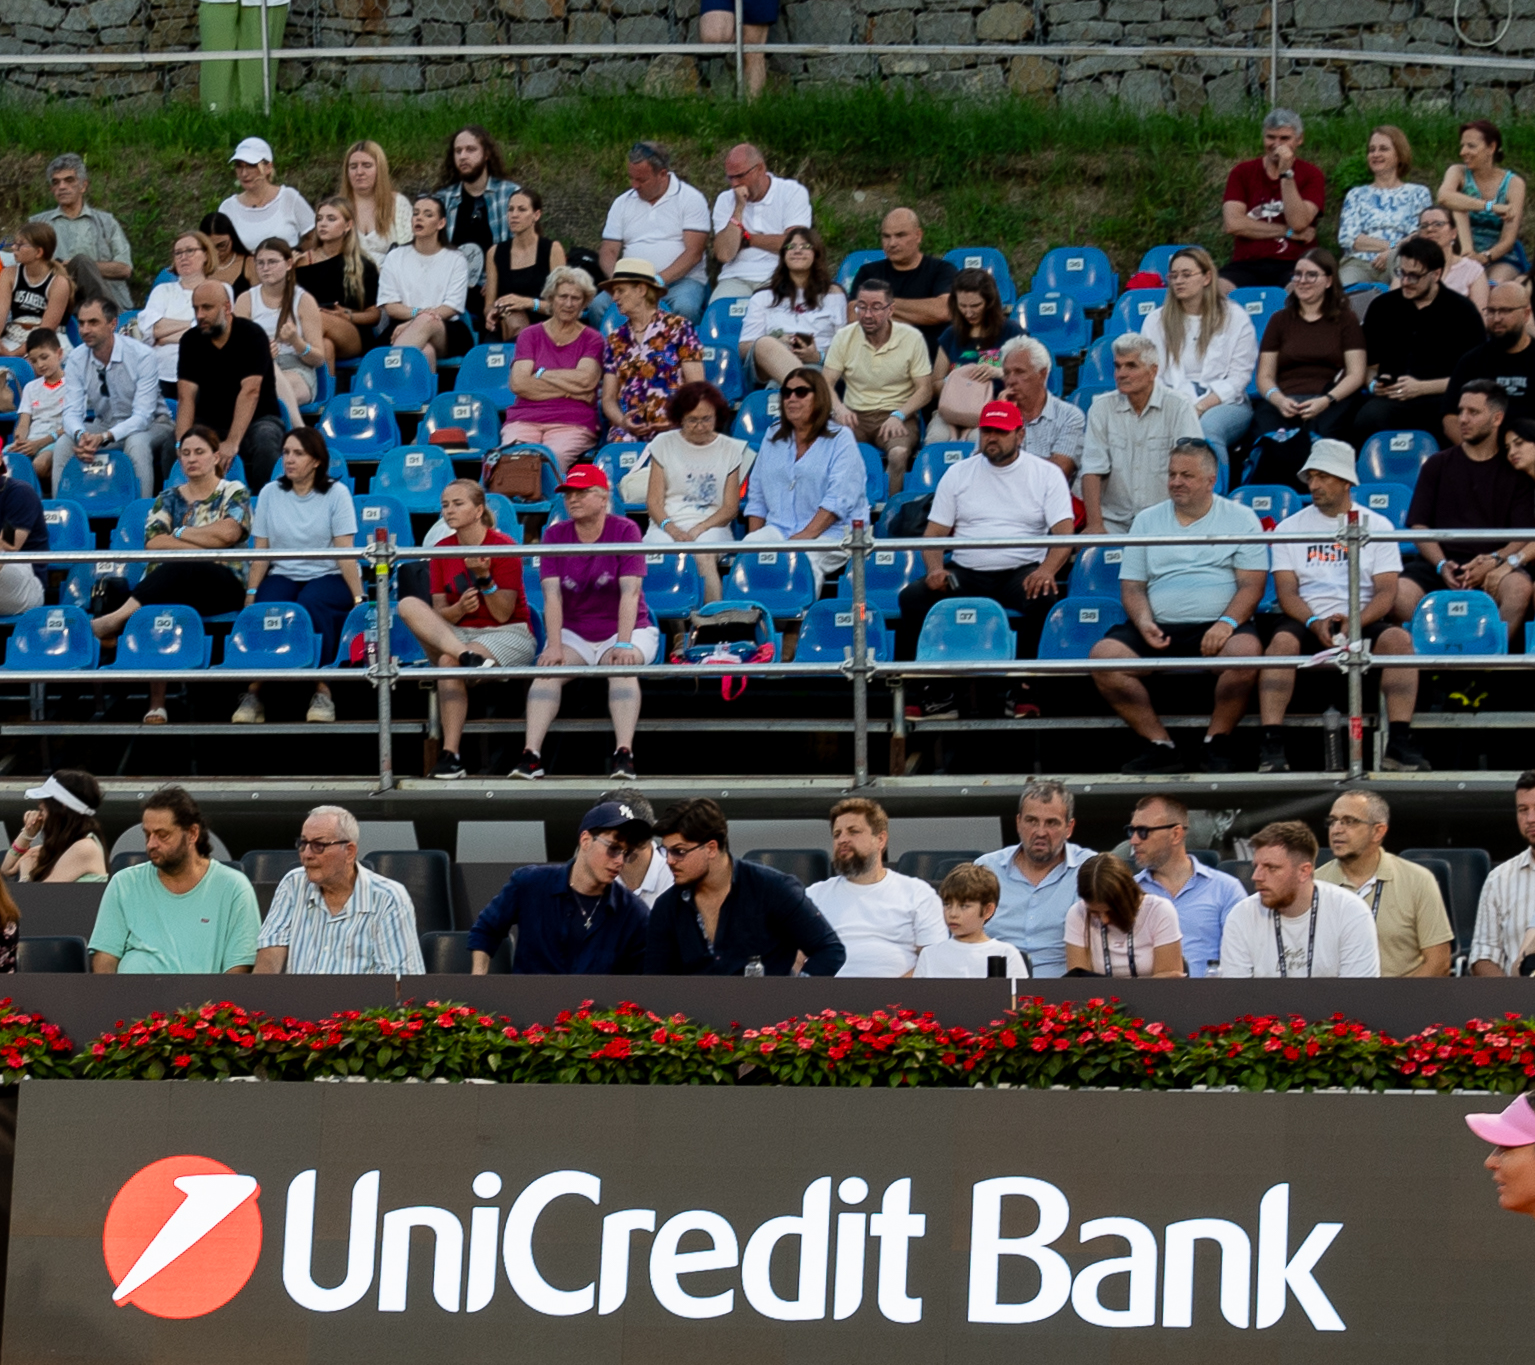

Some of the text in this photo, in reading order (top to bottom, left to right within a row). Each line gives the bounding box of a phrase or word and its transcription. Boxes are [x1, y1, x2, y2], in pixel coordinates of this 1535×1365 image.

[959, 612, 974, 620] 37
[283, 1170, 1347, 1332] UniCredit Bank
